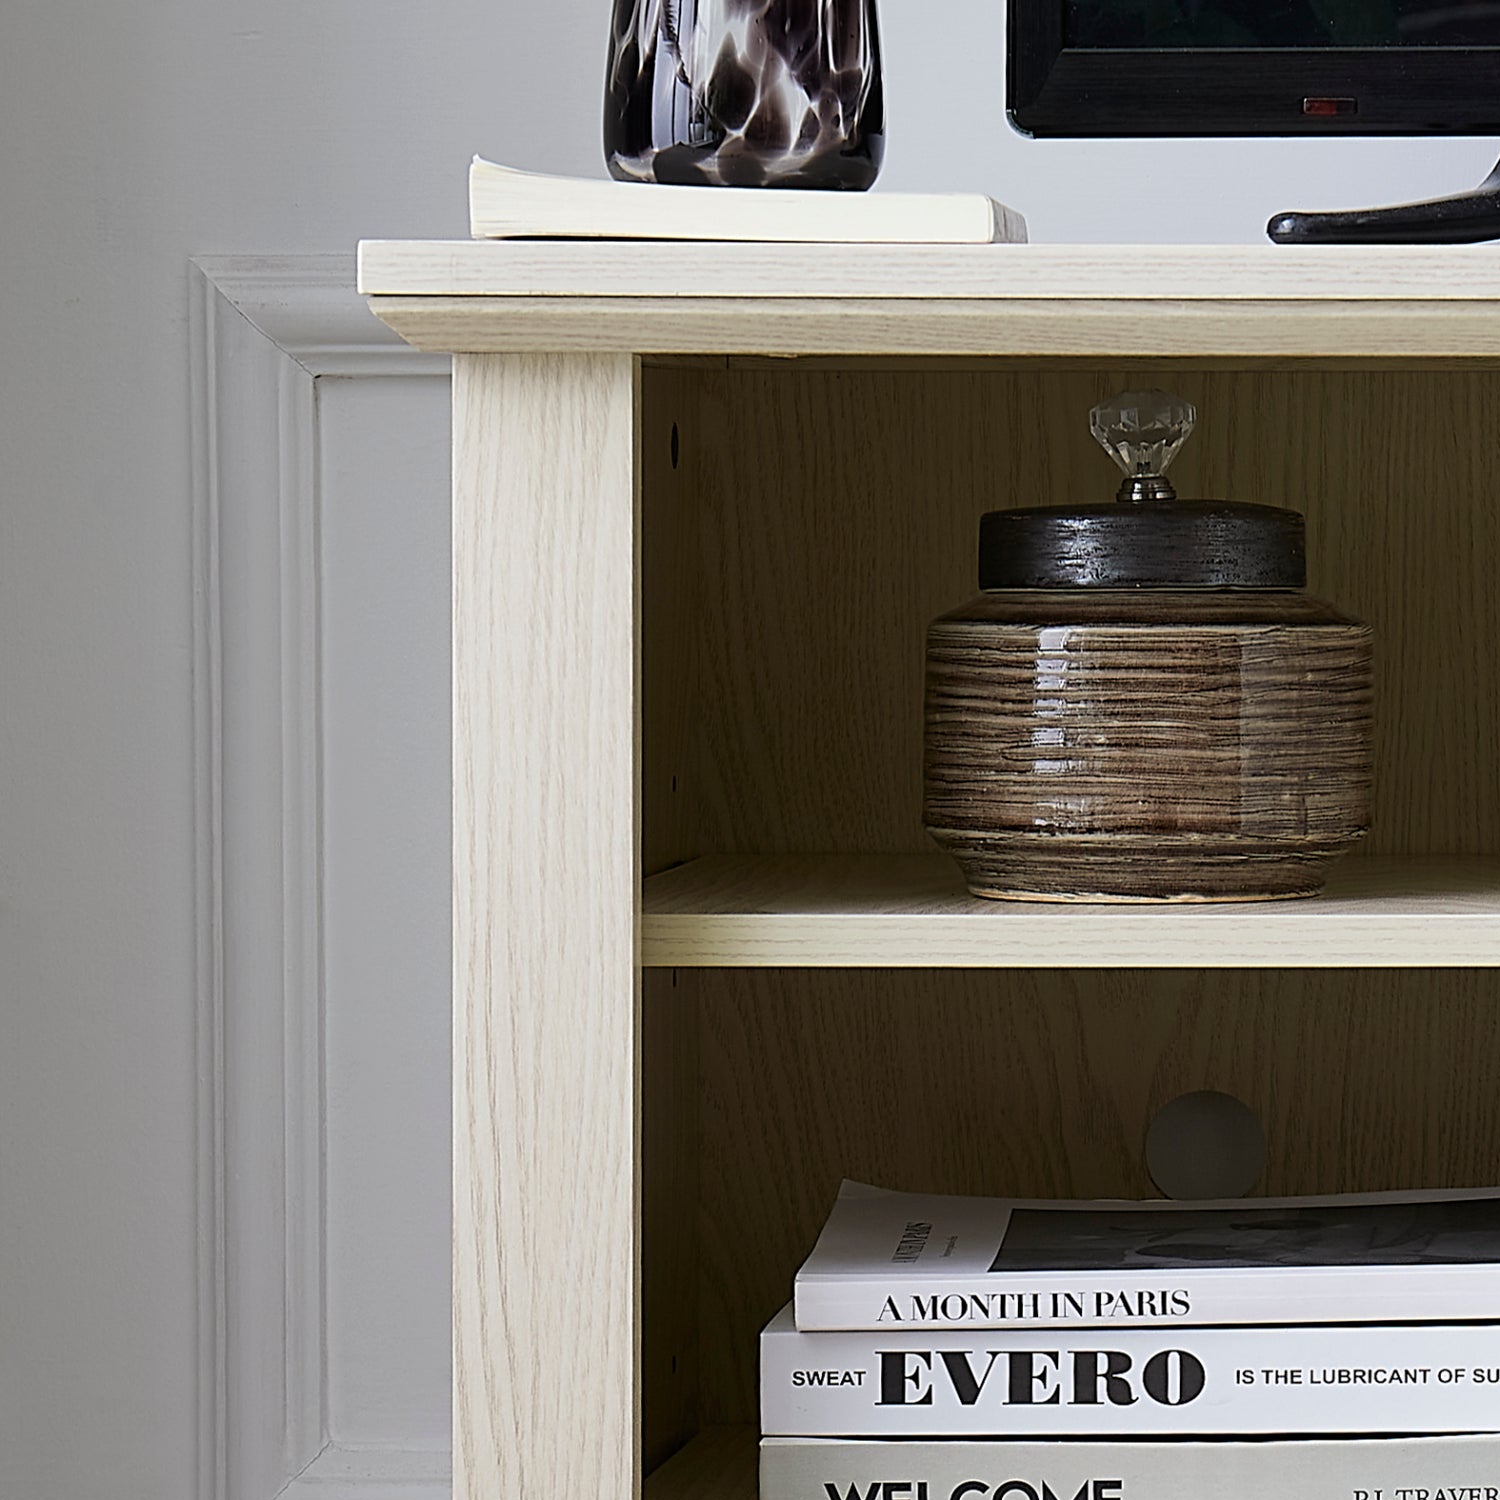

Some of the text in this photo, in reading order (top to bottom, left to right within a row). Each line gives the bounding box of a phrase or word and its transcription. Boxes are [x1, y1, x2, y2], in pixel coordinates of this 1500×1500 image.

[876, 1289, 1191, 1322] A MONTH IN PARIS
[791, 1370, 867, 1387] SWEAT
[873, 1349, 1206, 1407] EVERO
[1235, 1369, 1255, 1385] IS
[1260, 1369, 1303, 1385] THE
[1309, 1368, 1432, 1385] LUBRICANT
[1437, 1368, 1466, 1384] OF
